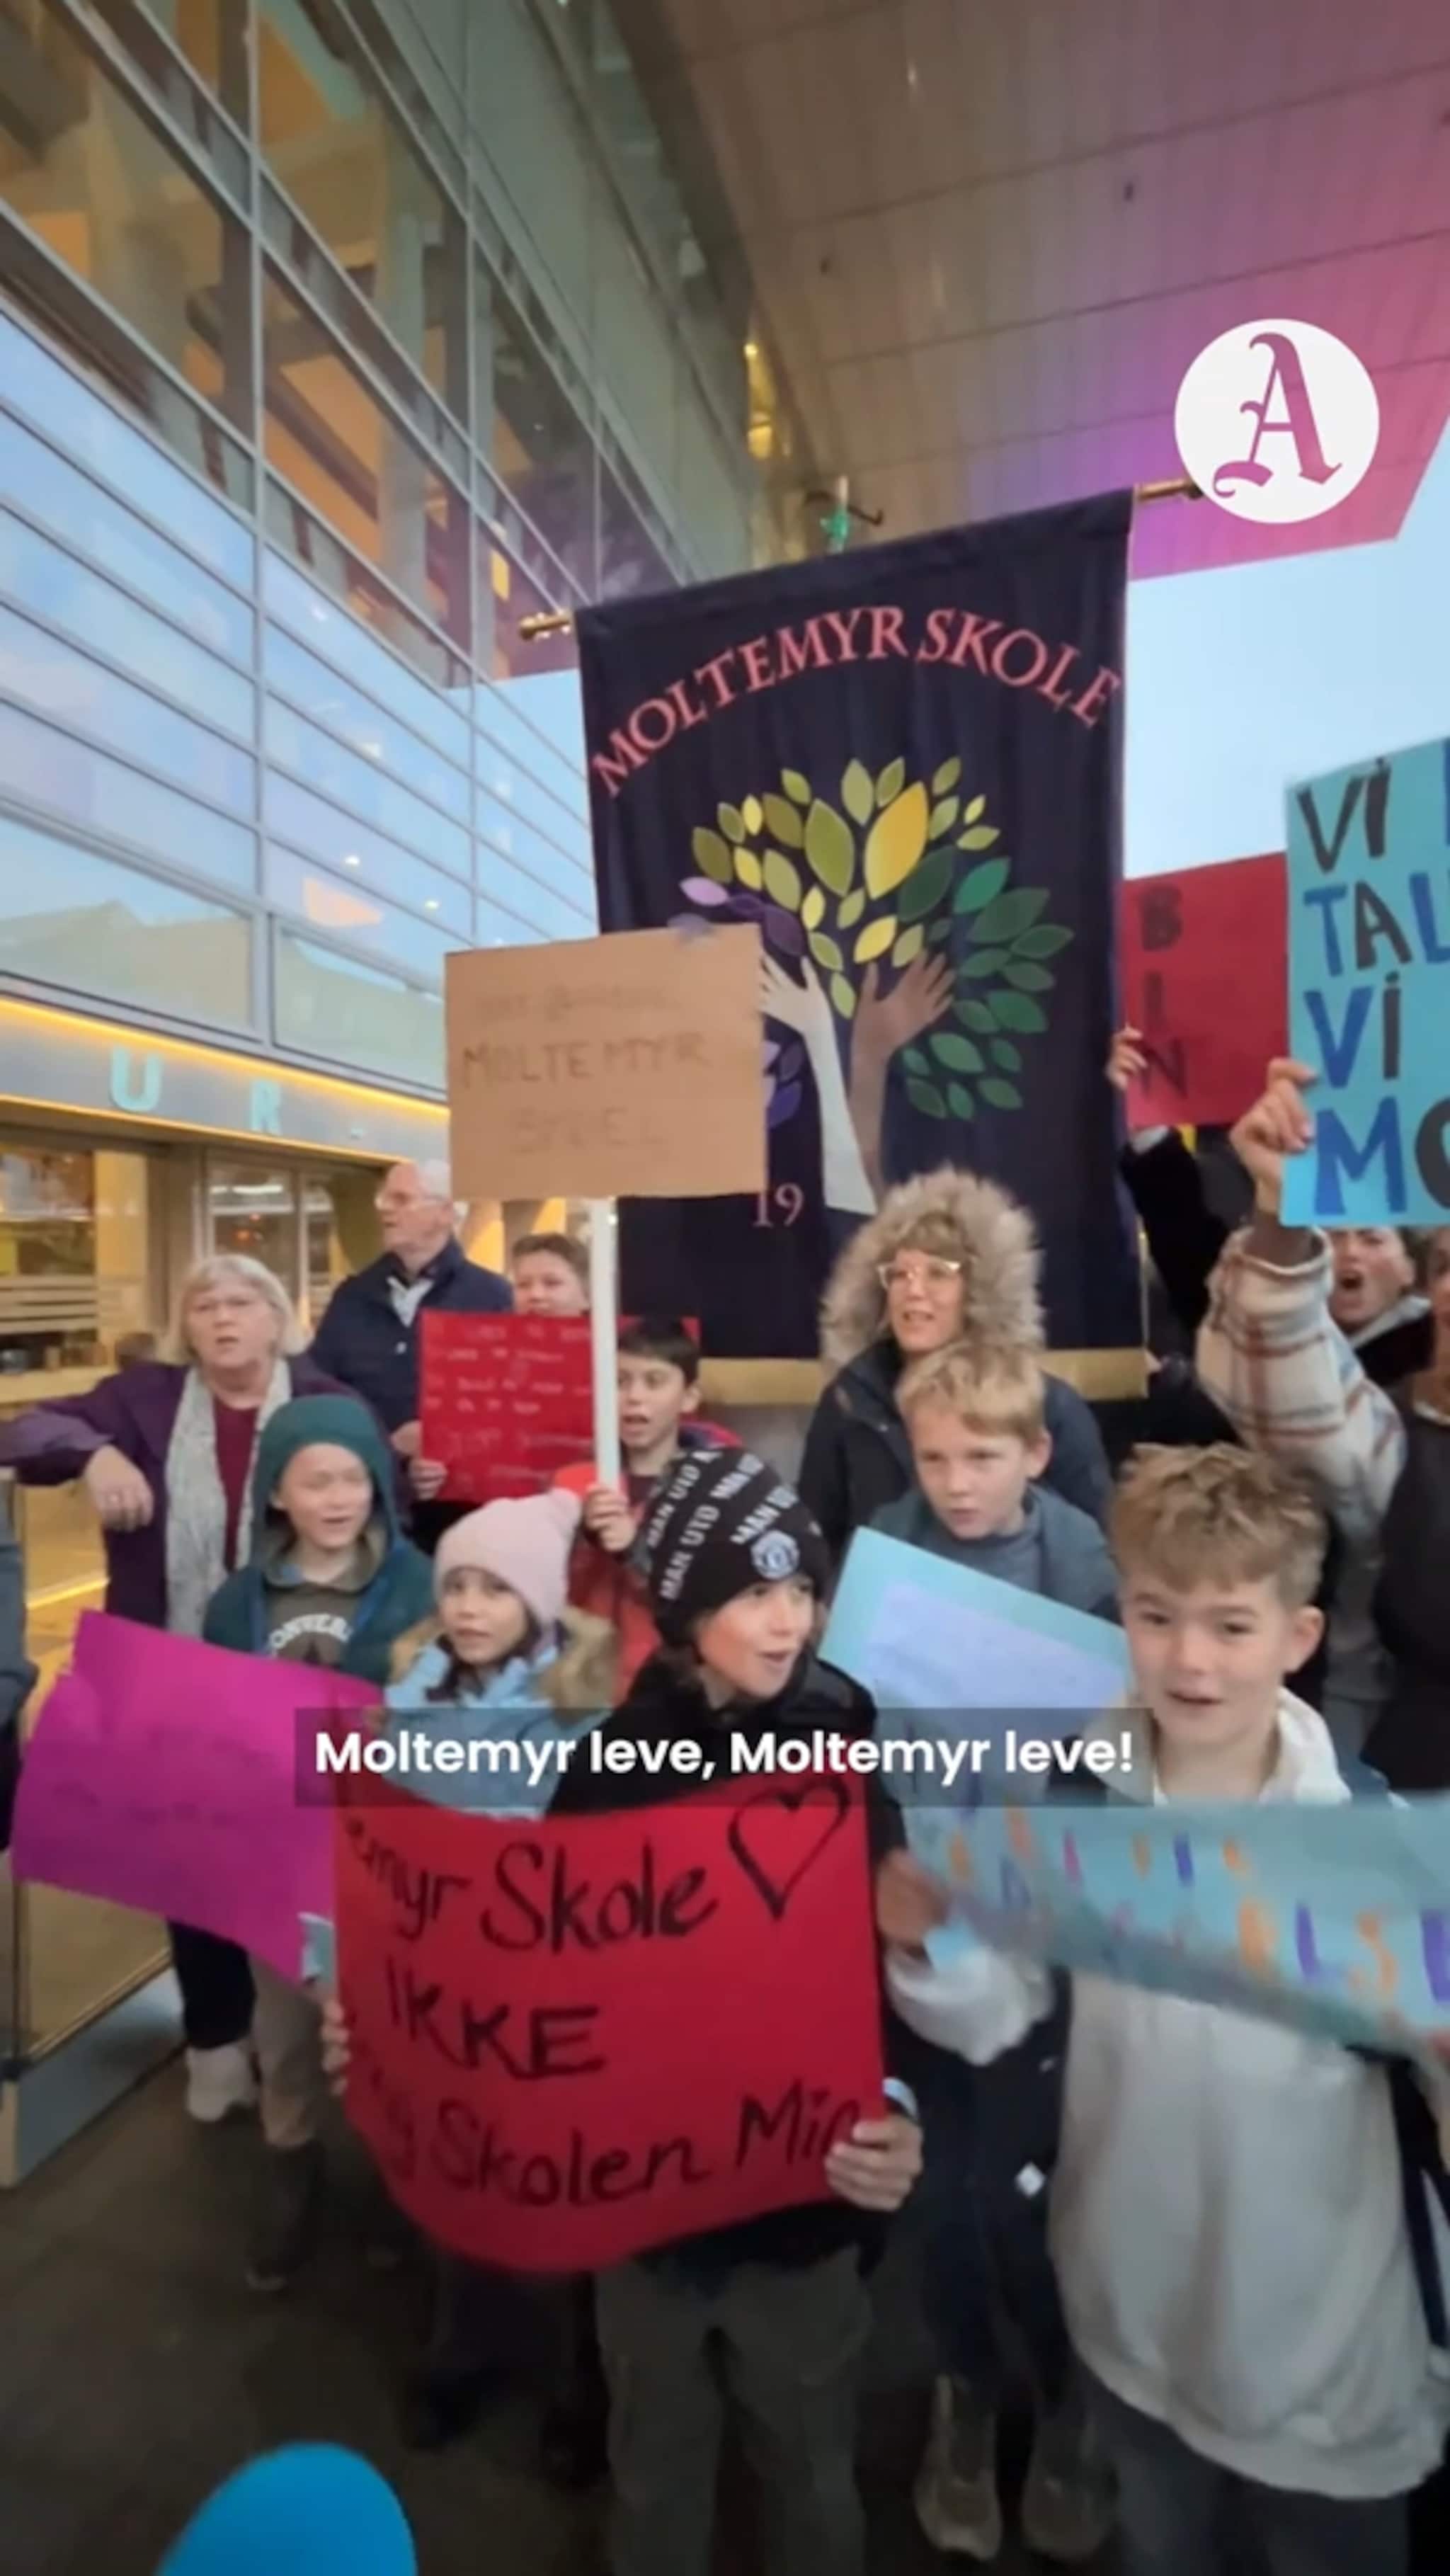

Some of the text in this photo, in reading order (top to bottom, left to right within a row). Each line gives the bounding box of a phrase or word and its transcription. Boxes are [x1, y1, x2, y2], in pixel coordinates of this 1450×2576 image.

[593, 605, 1122, 798] MOLTEMYR SKOLE
[752, 1181, 804, 1229] 19
[659, 1550, 693, 1601] MAN
[678, 1503, 720, 1547] UTD
[479, 1837, 719, 1954] Skole
[428, 2096, 710, 2207] Skolen
